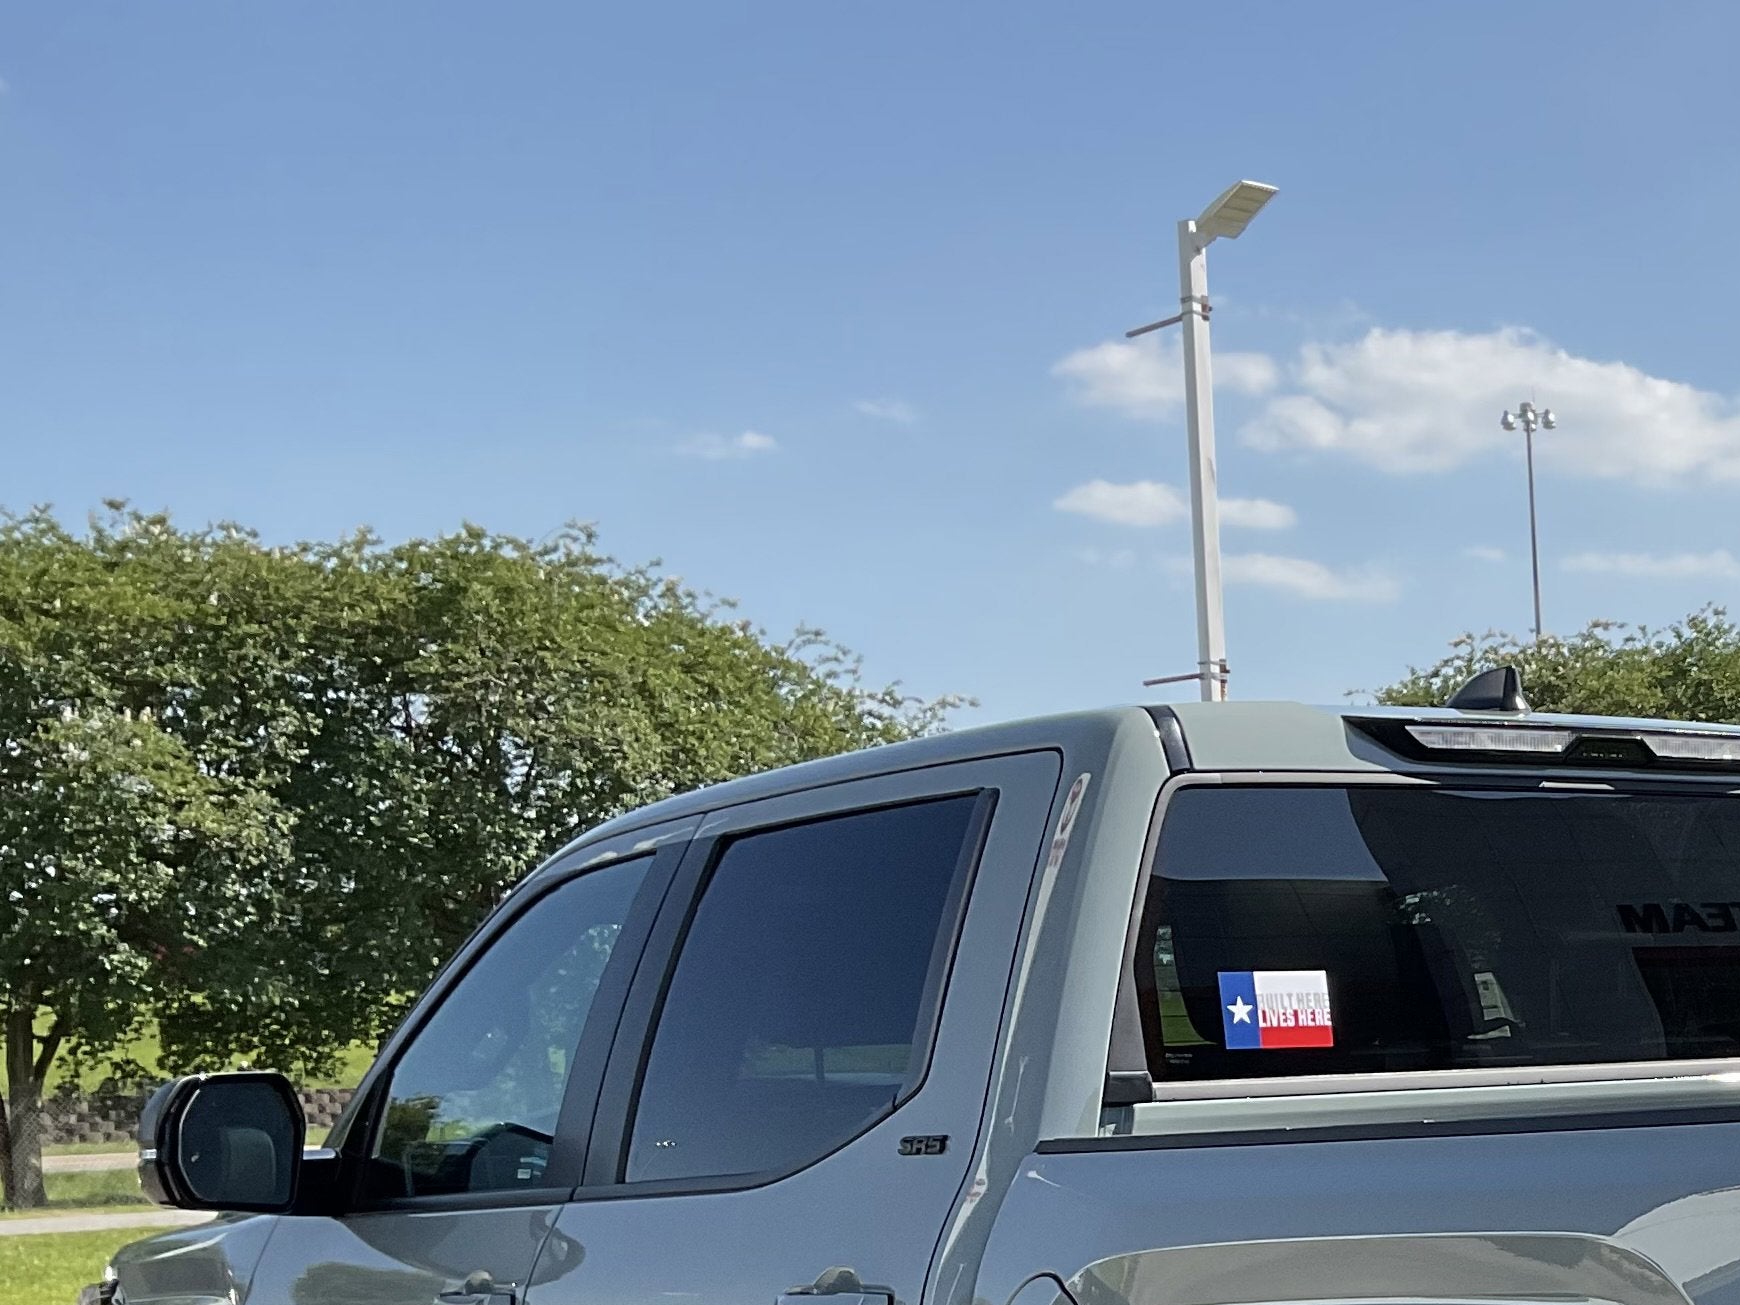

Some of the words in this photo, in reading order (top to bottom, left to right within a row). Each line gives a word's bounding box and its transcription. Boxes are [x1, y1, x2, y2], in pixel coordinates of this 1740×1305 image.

[1296, 992, 1329, 1010] HERE
[1259, 1009, 1295, 1027] LIVES
[1298, 1008, 1332, 1026] HERE
